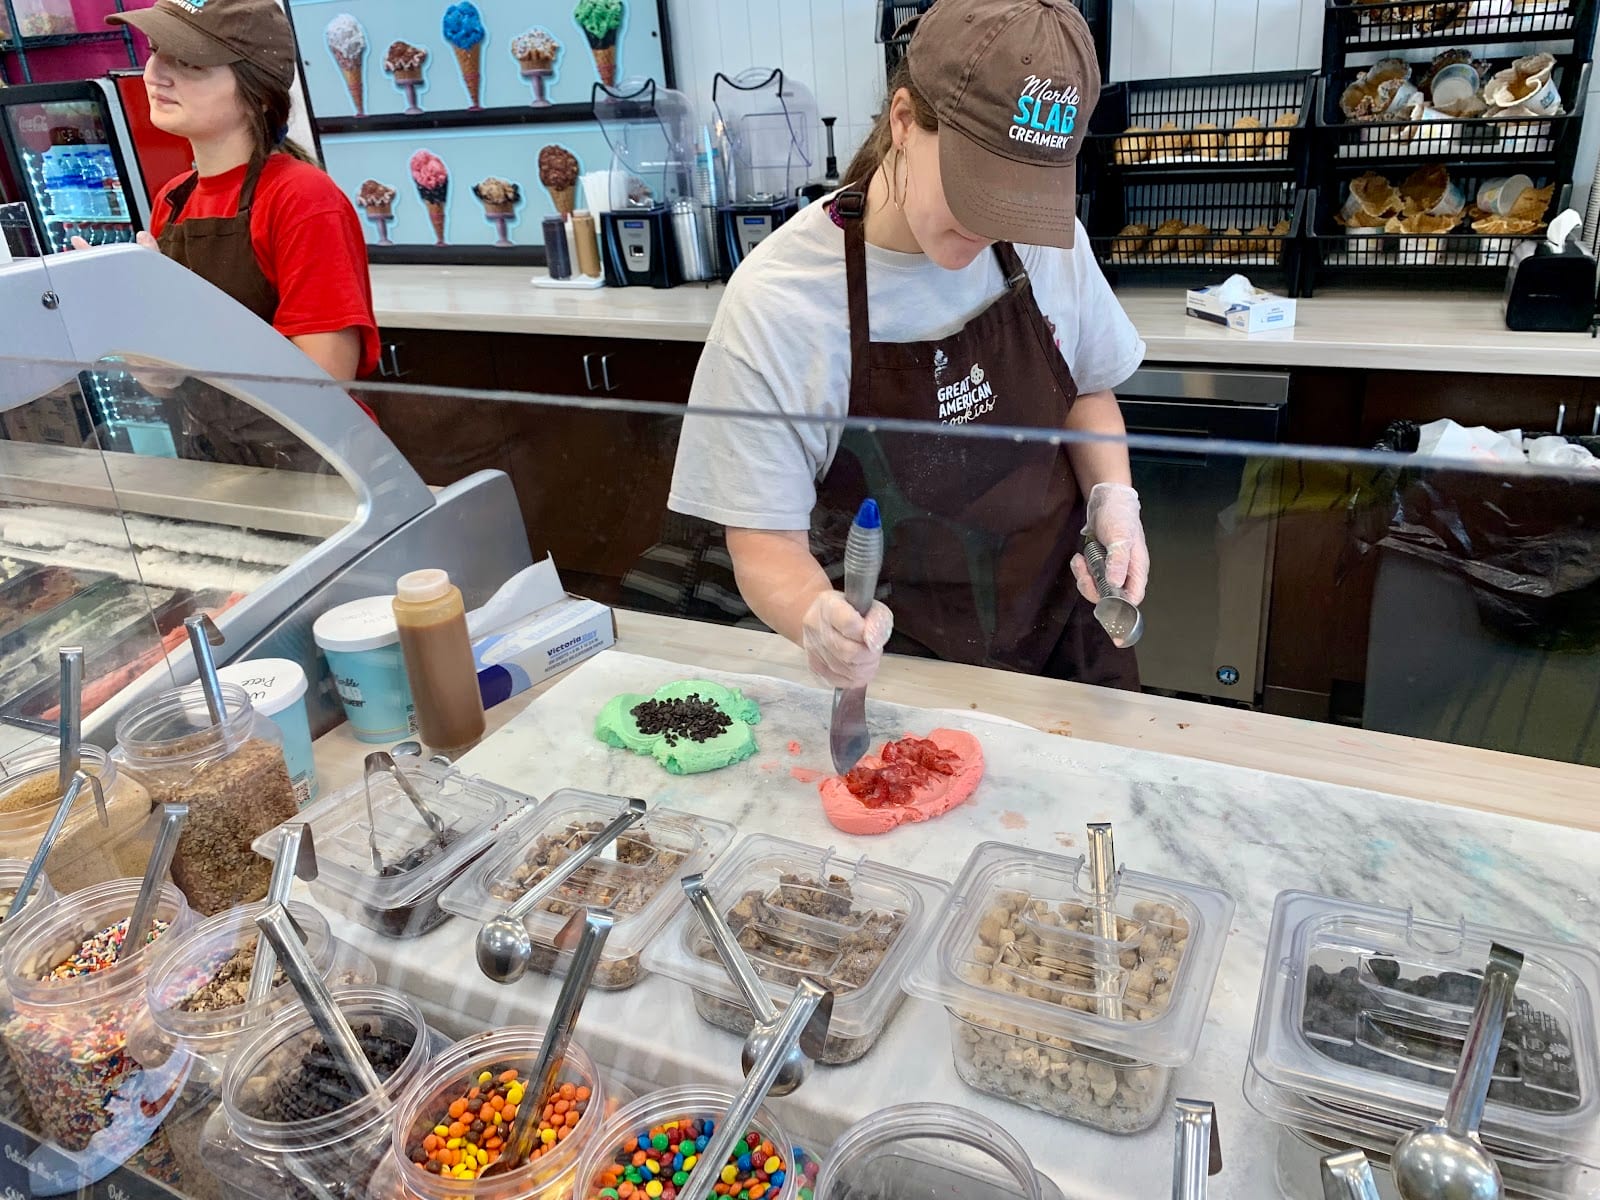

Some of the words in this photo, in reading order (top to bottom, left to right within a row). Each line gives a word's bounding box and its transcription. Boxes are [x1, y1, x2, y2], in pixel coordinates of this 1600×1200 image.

[1020, 74, 1080, 105] Marble
[1013, 95, 1077, 134] SLAB
[1008, 125, 1070, 149] CREAMERY
[937, 376, 971, 402] GREAT
[938, 381, 993, 418] AMERICAN
[547, 636, 582, 656] Victoria
